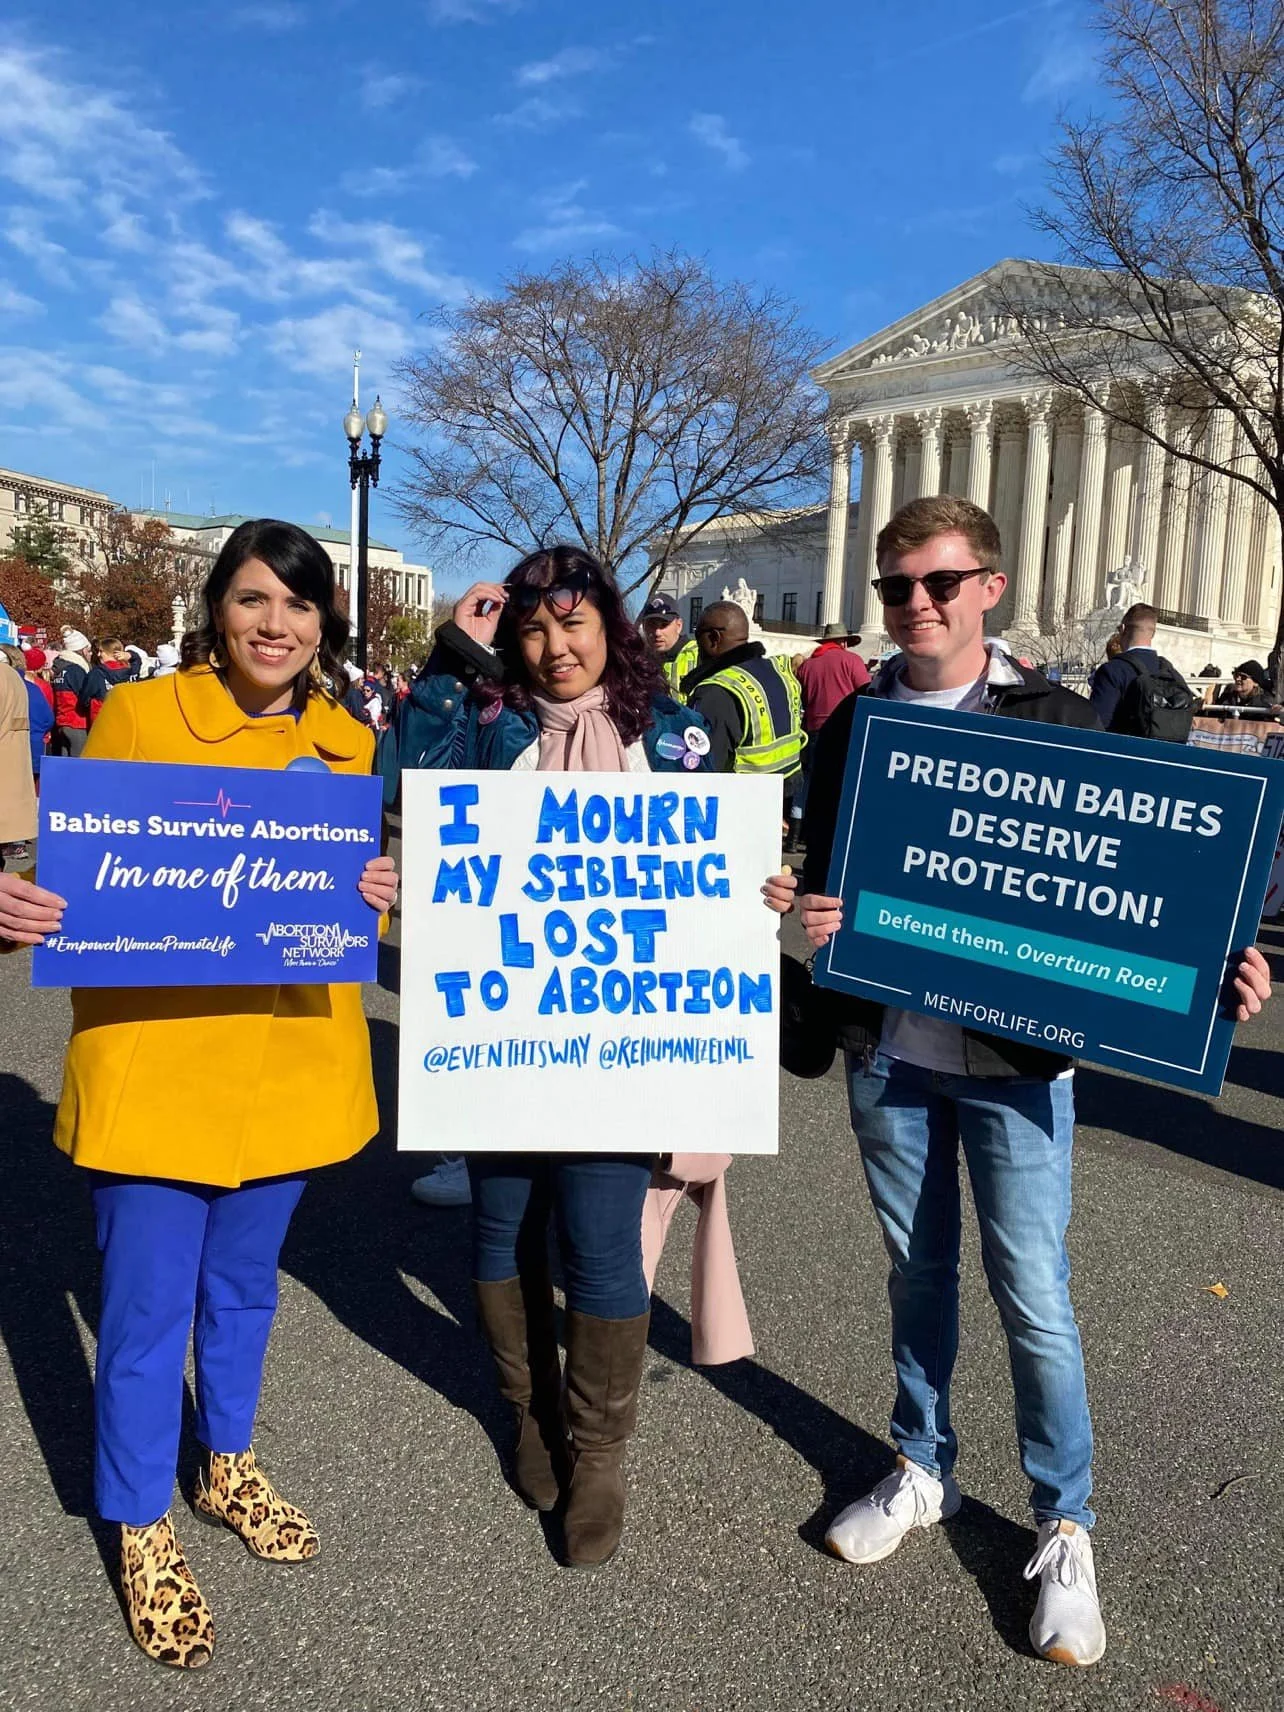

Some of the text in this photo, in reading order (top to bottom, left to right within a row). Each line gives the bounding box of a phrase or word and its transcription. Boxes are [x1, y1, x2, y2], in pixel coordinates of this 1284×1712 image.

[738, 675, 765, 716] USCP
[438, 783, 719, 847] I MOURN
[887, 751, 1066, 809] PREBORN
[1074, 782, 1223, 837] BABIES
[48, 811, 375, 843] Babies Survive Abortions.
[948, 808, 1121, 869] DESERVE
[95, 851, 336, 909] I'm one of them.
[431, 853, 731, 907] MY SIBLING
[903, 845, 1164, 928] PROTECTION!
[46, 935, 237, 957] #EmpowerWomenPromoteLife
[266, 922, 340, 940] ABORTION
[282, 947, 345, 958] NETWORK
[300, 931, 369, 948] SURVIVORS
[498, 908, 668, 969] LOST
[878, 909, 1168, 994] Defend them. Overturn Roe!
[434, 965, 773, 1018] TO ABORTION
[924, 990, 1085, 1049] MENFORLIFE.ORG
[423, 1033, 592, 1073] @EVENTHISWAY
